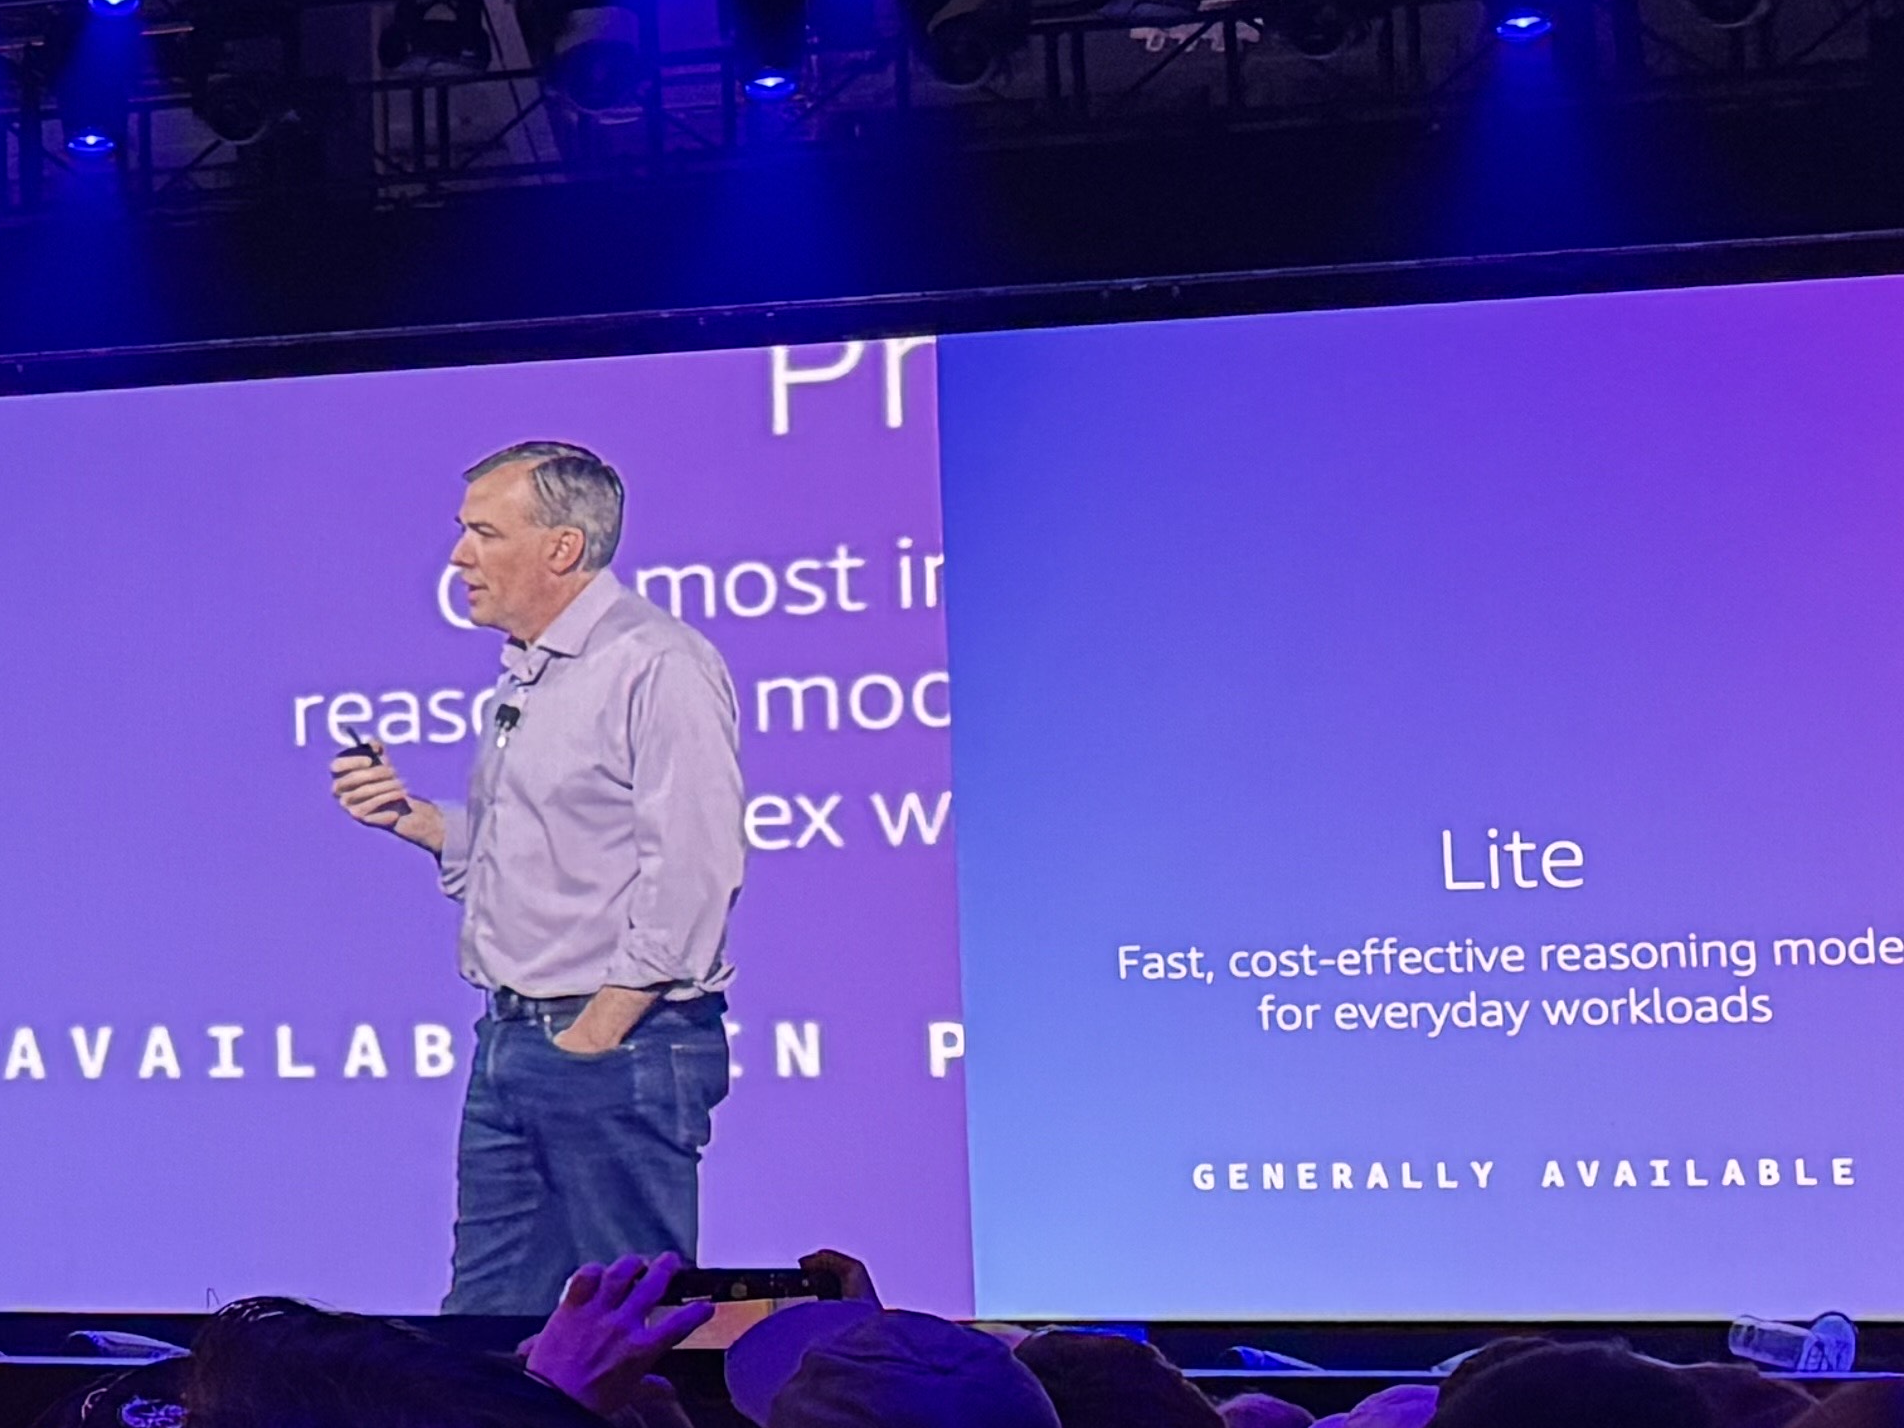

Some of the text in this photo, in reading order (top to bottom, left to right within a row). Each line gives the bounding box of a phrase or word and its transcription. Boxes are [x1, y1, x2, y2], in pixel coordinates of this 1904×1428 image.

[636, 544, 868, 619] most
[1442, 828, 1584, 890] Lite
[1118, 945, 1214, 985] Fast,
[1229, 937, 1525, 978] cost-effective
[1540, 932, 1757, 977] reasoning
[1257, 985, 1773, 1038] for everyday workloads
[1192, 1157, 1855, 1191] GENERALLY AVAILABLE
